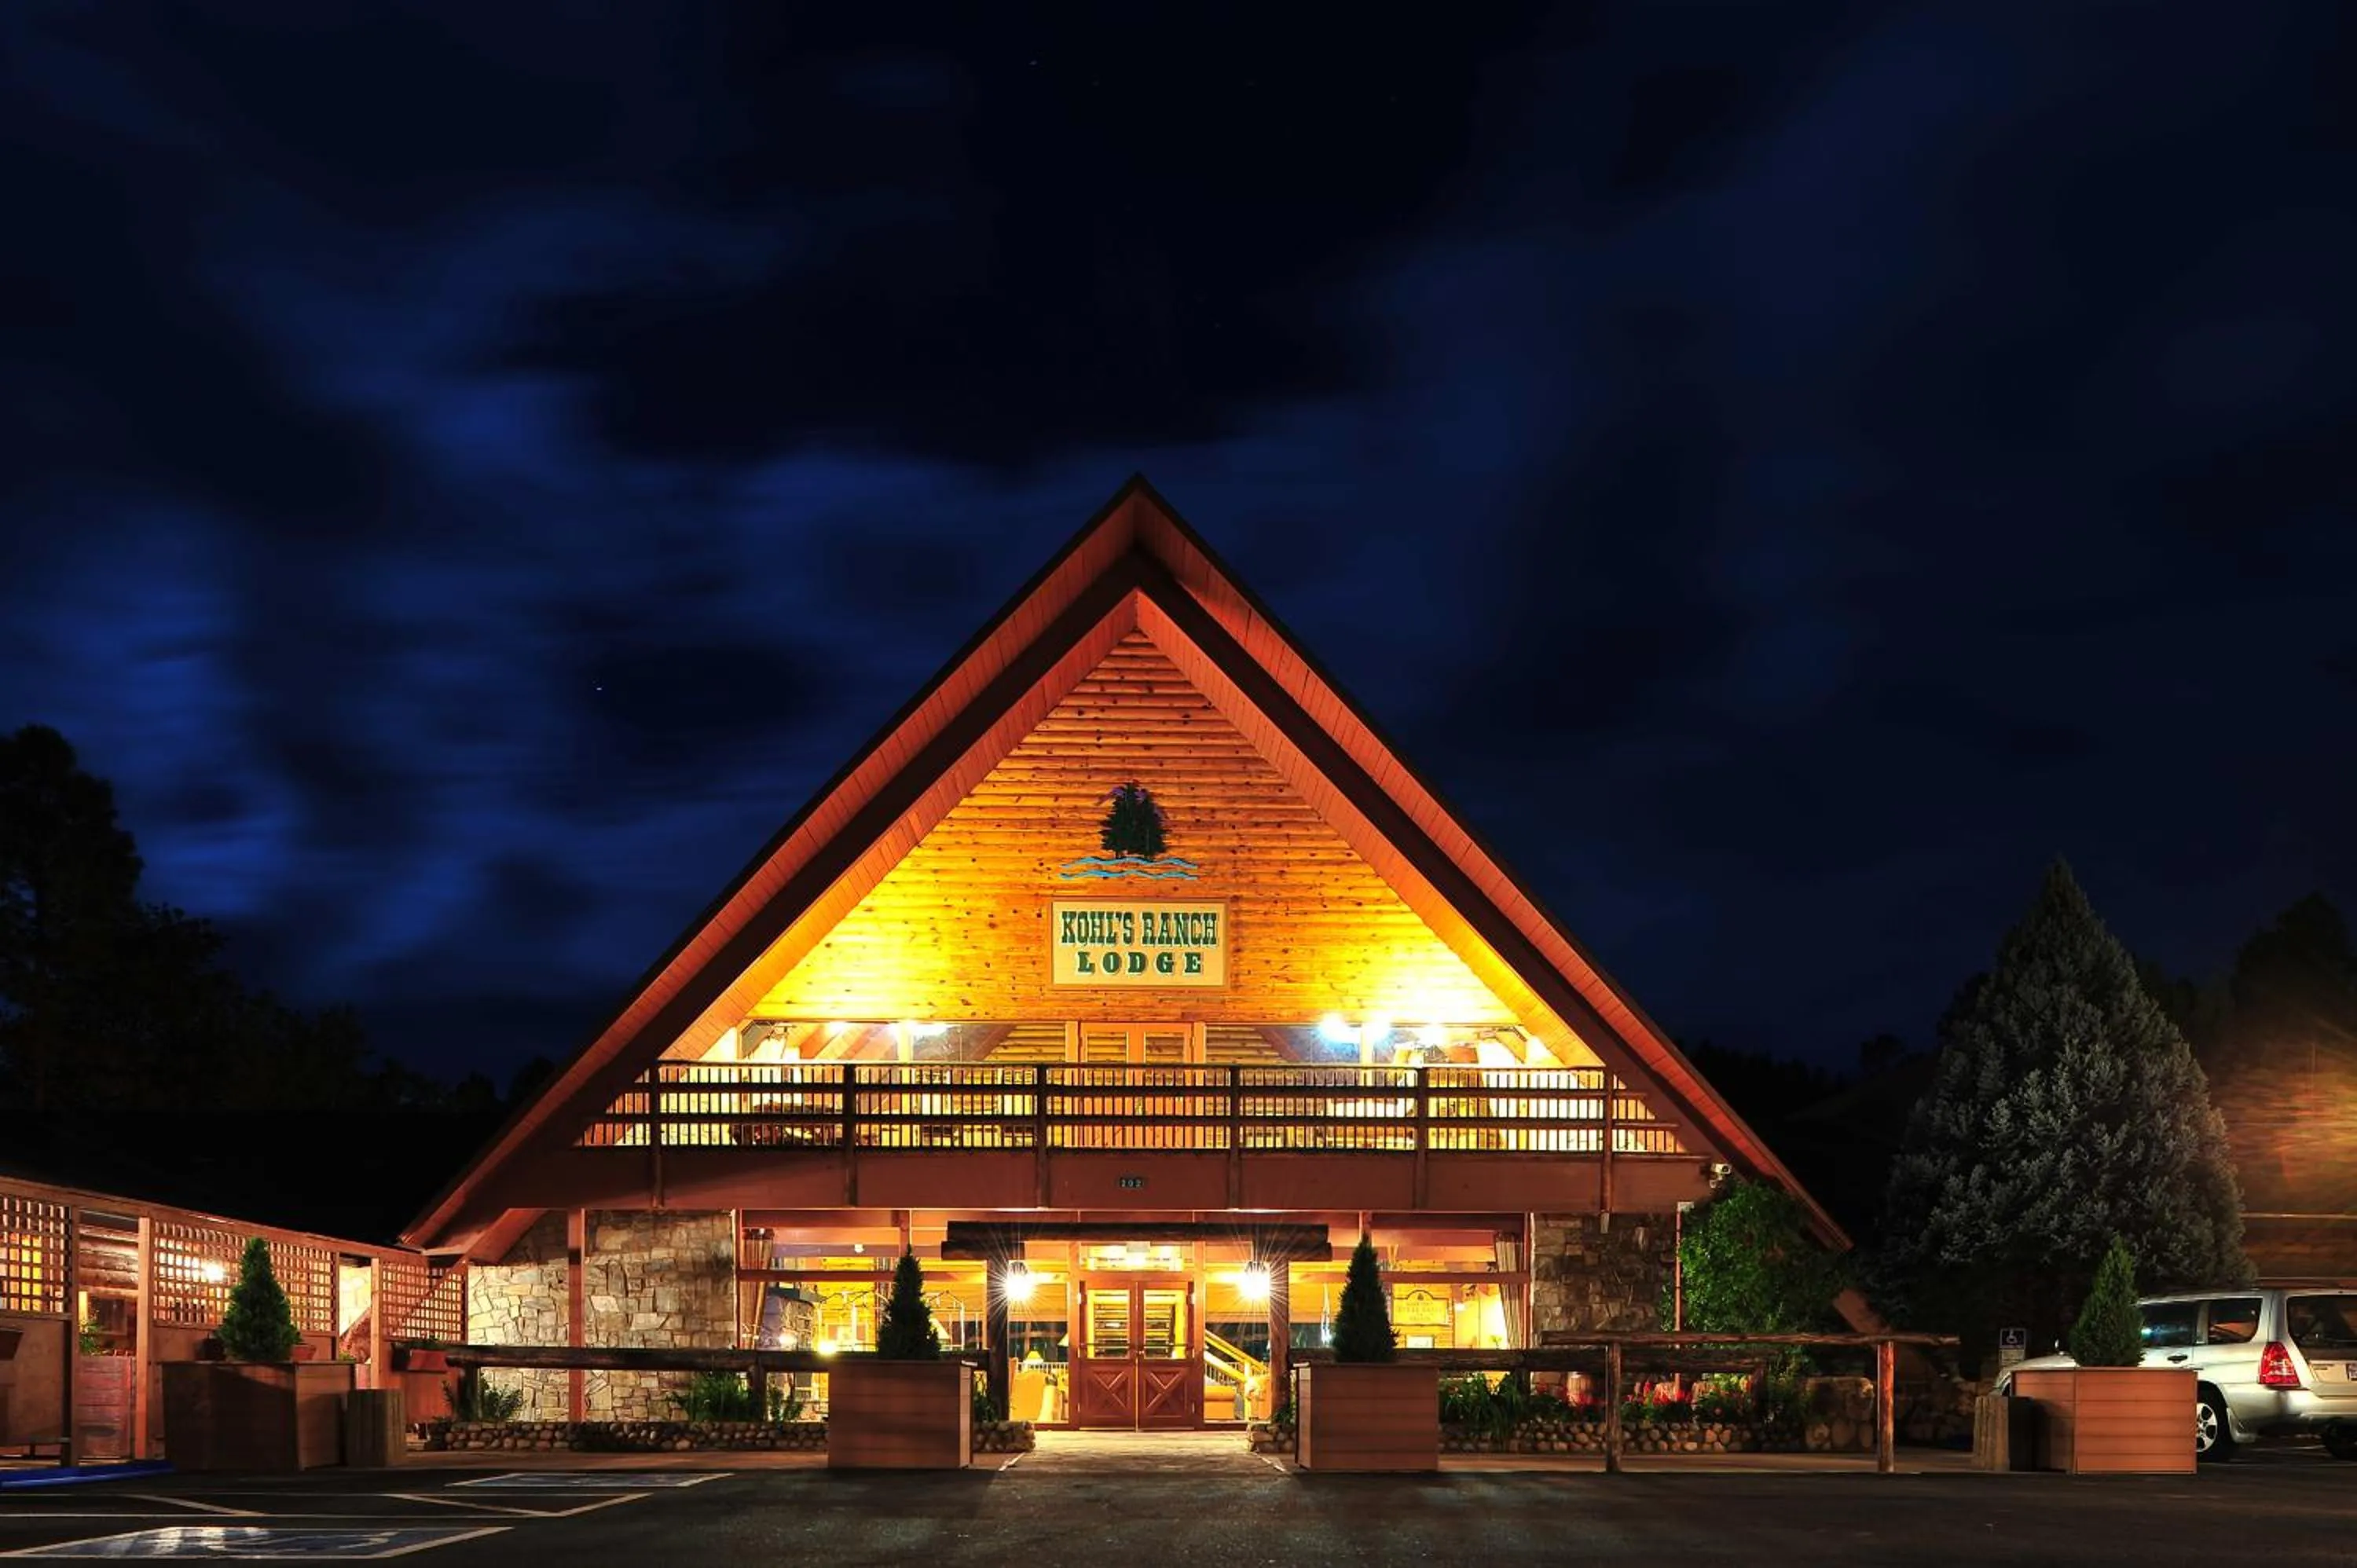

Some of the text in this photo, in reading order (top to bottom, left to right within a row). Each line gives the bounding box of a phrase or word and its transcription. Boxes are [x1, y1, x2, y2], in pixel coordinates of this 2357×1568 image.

[1061, 910, 1217, 945] KOHL'S RANCH
[1077, 951, 1202, 973] LODGE
